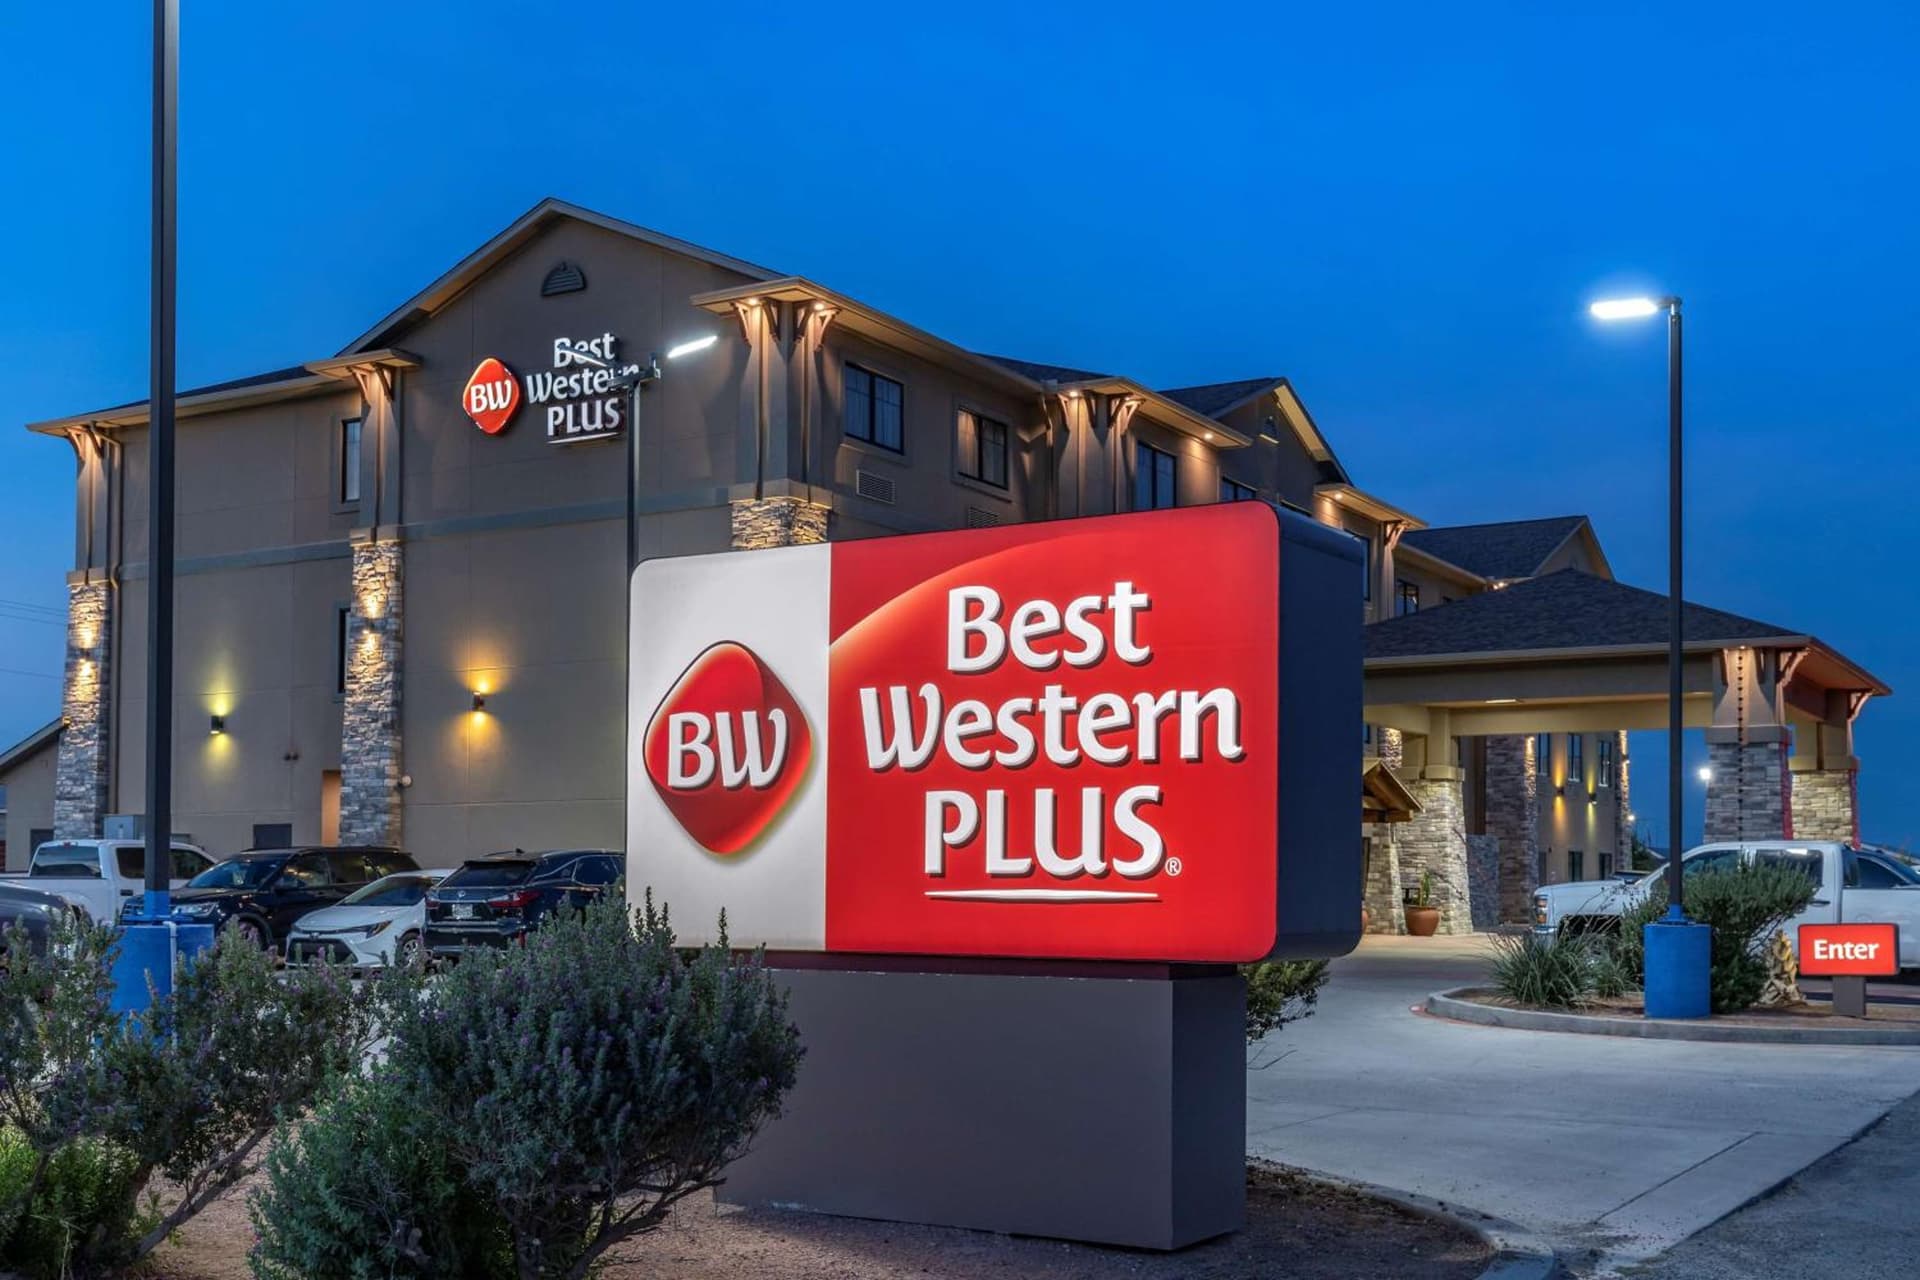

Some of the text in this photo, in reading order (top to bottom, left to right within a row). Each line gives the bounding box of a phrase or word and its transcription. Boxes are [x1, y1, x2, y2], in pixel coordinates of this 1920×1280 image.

[554, 332, 615, 368] Best
[470, 380, 512, 414] BW
[547, 397, 621, 436] PLUS
[947, 581, 1152, 672] Best
[859, 682, 1243, 770] Western
[667, 707, 788, 789] BW
[1813, 938, 1880, 960] Enter
